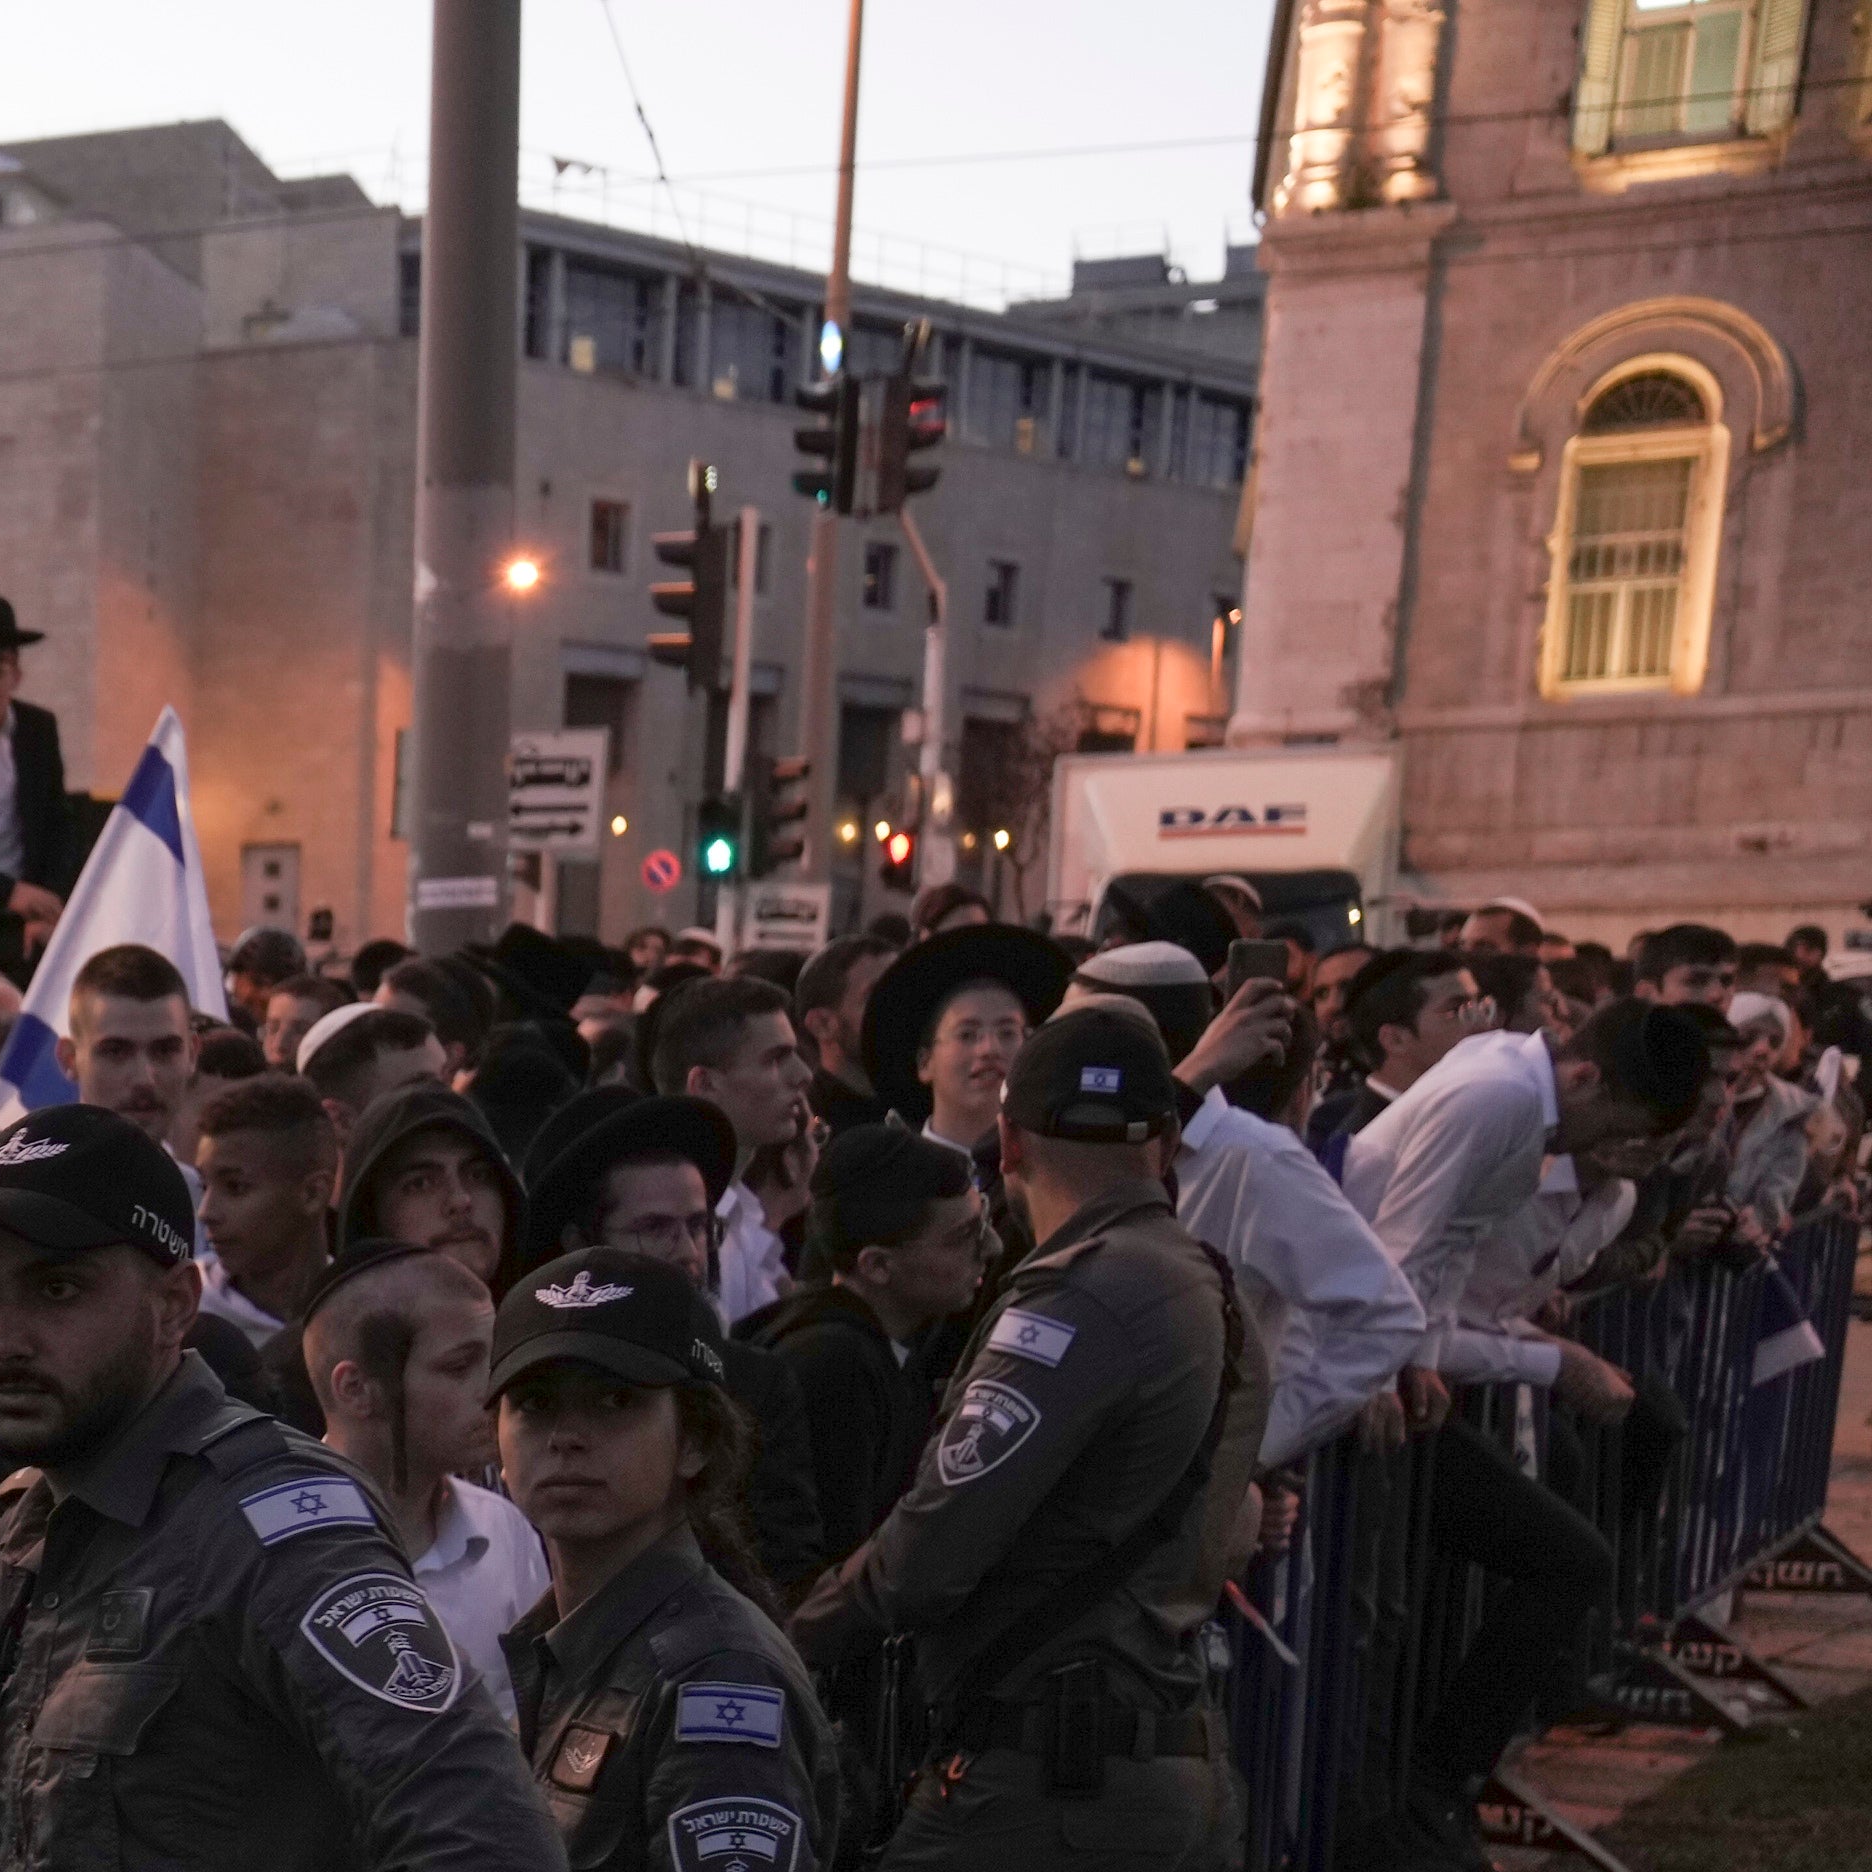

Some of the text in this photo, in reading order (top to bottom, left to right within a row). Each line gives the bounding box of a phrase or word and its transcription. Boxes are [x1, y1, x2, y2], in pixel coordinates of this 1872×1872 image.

[1158, 803, 1308, 829] DAF
[314, 1590, 367, 1628] ישראל
[681, 1810, 791, 1835] משטרת ישראל
